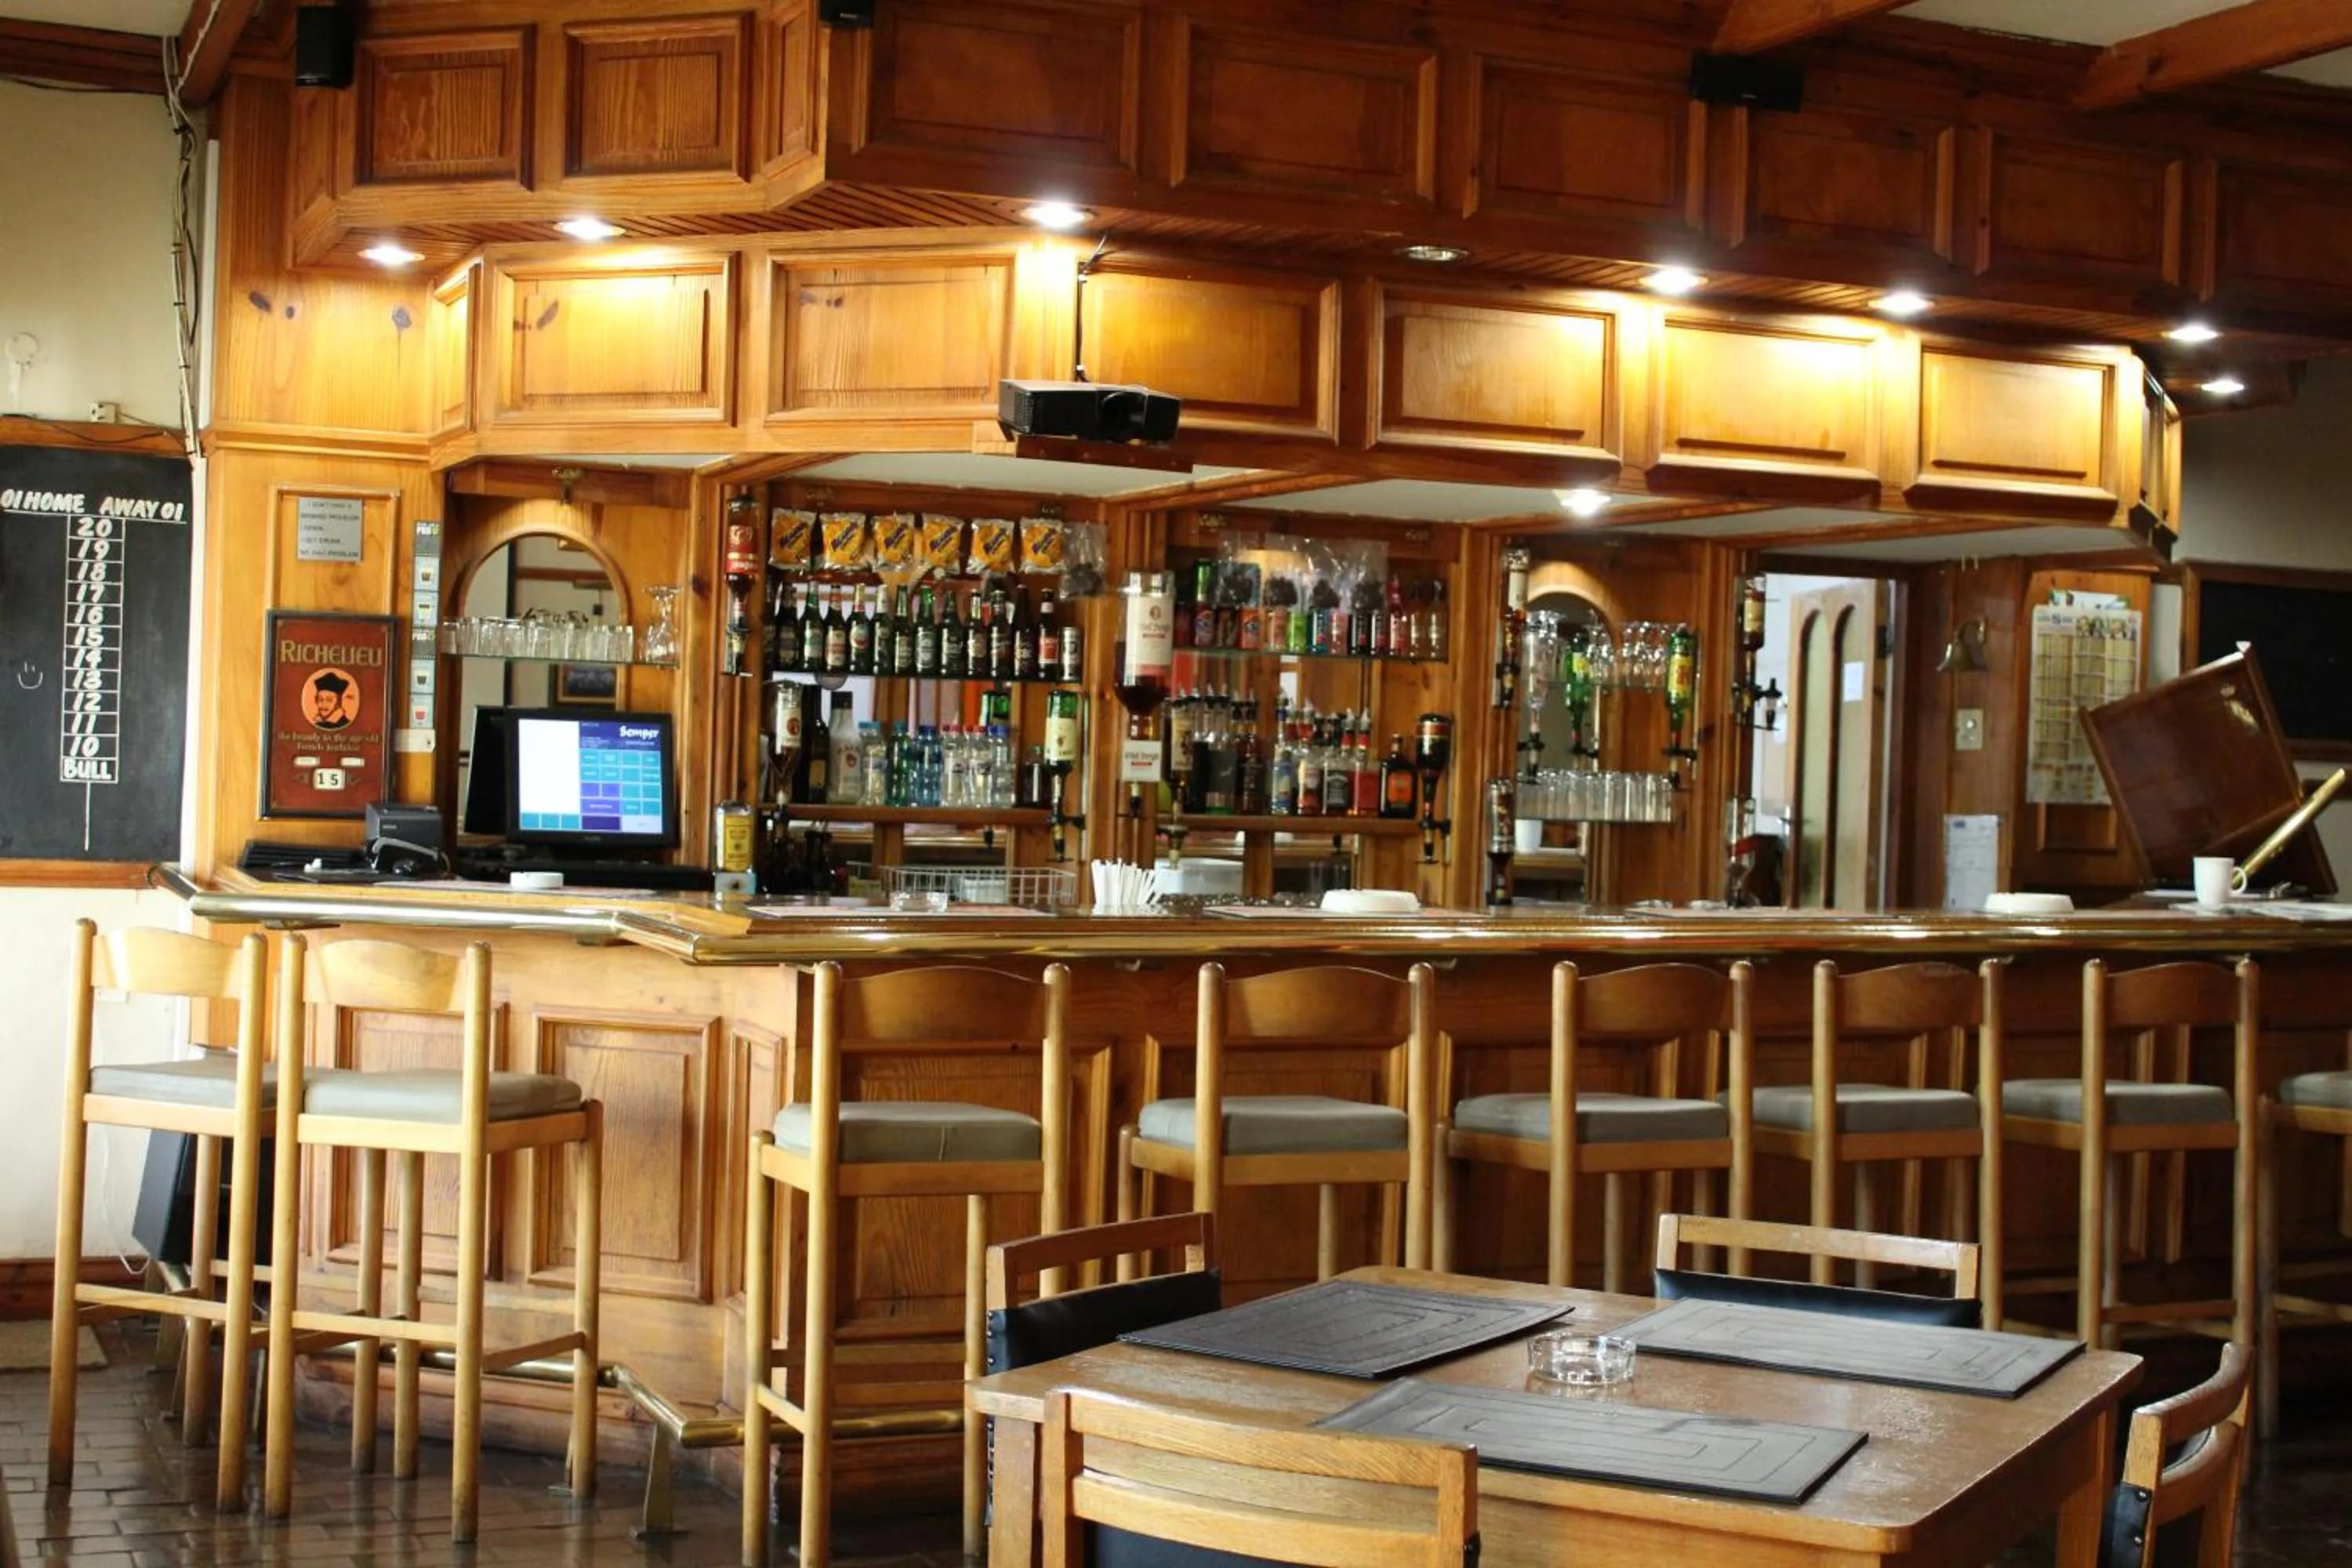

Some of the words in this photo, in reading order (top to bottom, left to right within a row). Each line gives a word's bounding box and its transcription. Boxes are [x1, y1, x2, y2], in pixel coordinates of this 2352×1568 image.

[23, 491, 85, 514] HOME
[99, 496, 159, 519] AWAY
[77, 517, 113, 537] 20
[78, 539, 110, 560] 19
[78, 561, 107, 582] 18
[76, 583, 105, 603] 17
[74, 604, 104, 625] 16
[74, 626, 104, 647] 15
[73, 648, 103, 668] 14
[72, 670, 103, 689] 13
[72, 691, 102, 712] 12
[71, 712, 96, 734] 11
[70, 735, 100, 757] 10
[64, 757, 111, 779] BULL
[318, 772, 338, 786] 15
